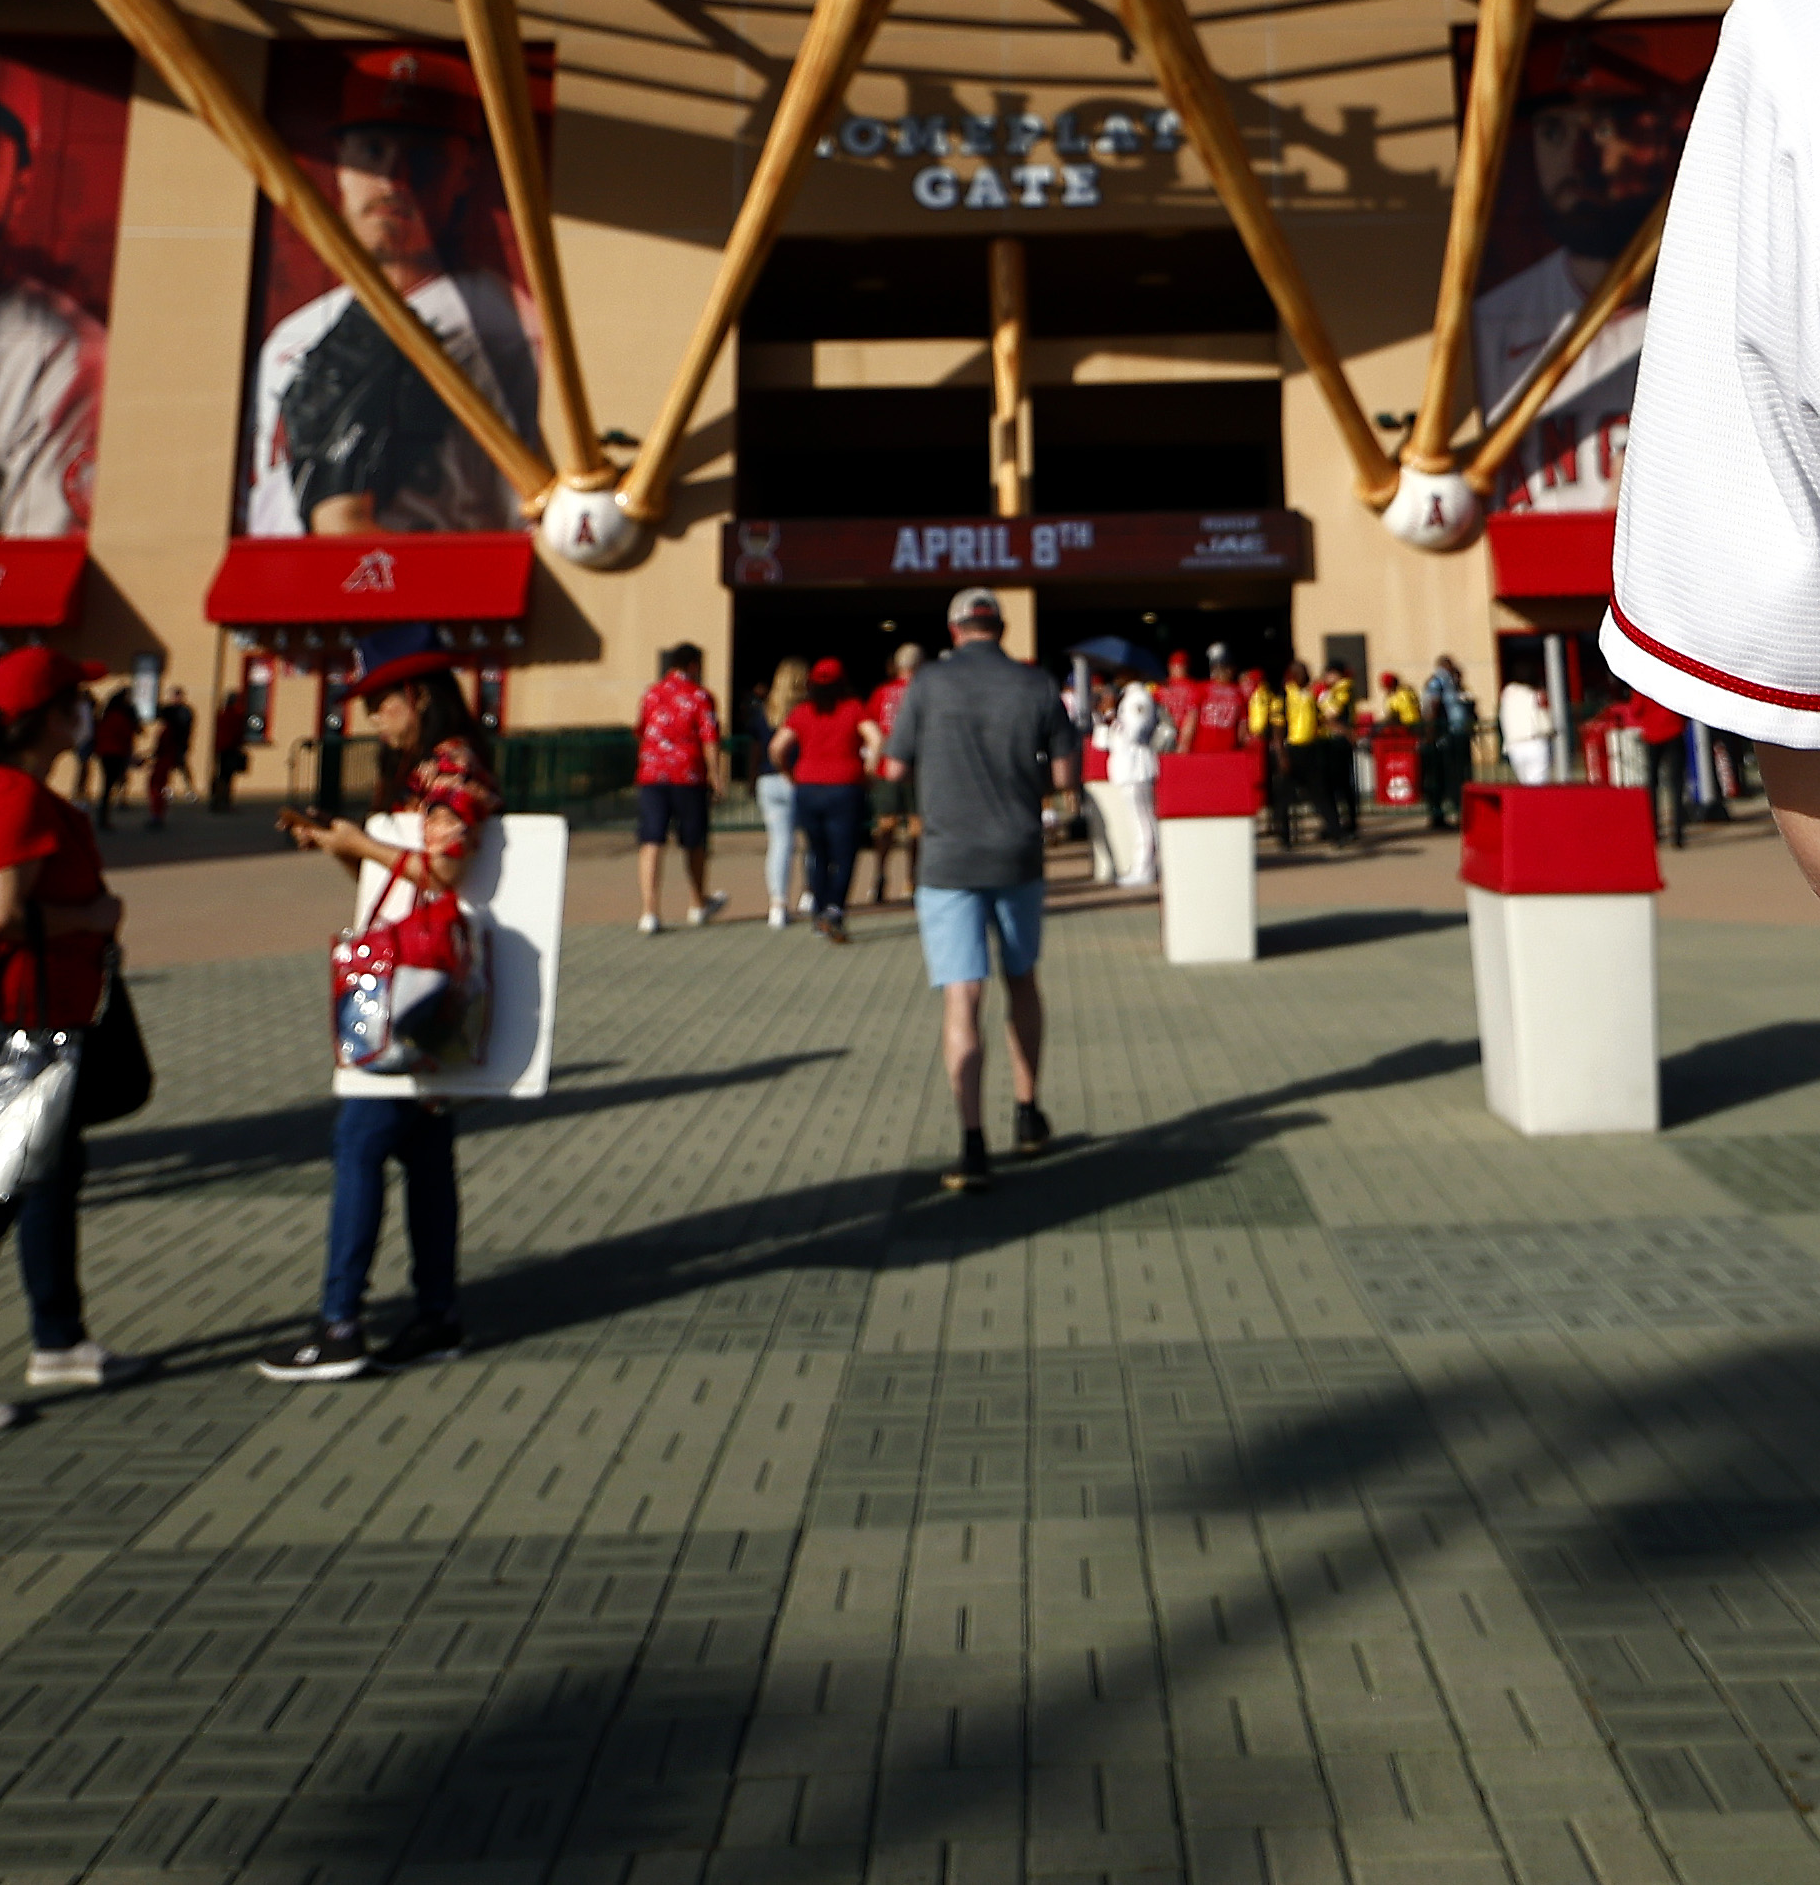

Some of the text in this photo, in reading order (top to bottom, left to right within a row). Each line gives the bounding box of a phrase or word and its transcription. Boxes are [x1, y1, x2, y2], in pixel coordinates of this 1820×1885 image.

[814, 109, 1184, 160] OMEPLAT
[911, 164, 1102, 209] GATE
[890, 520, 1095, 572] APRIL 8TH
